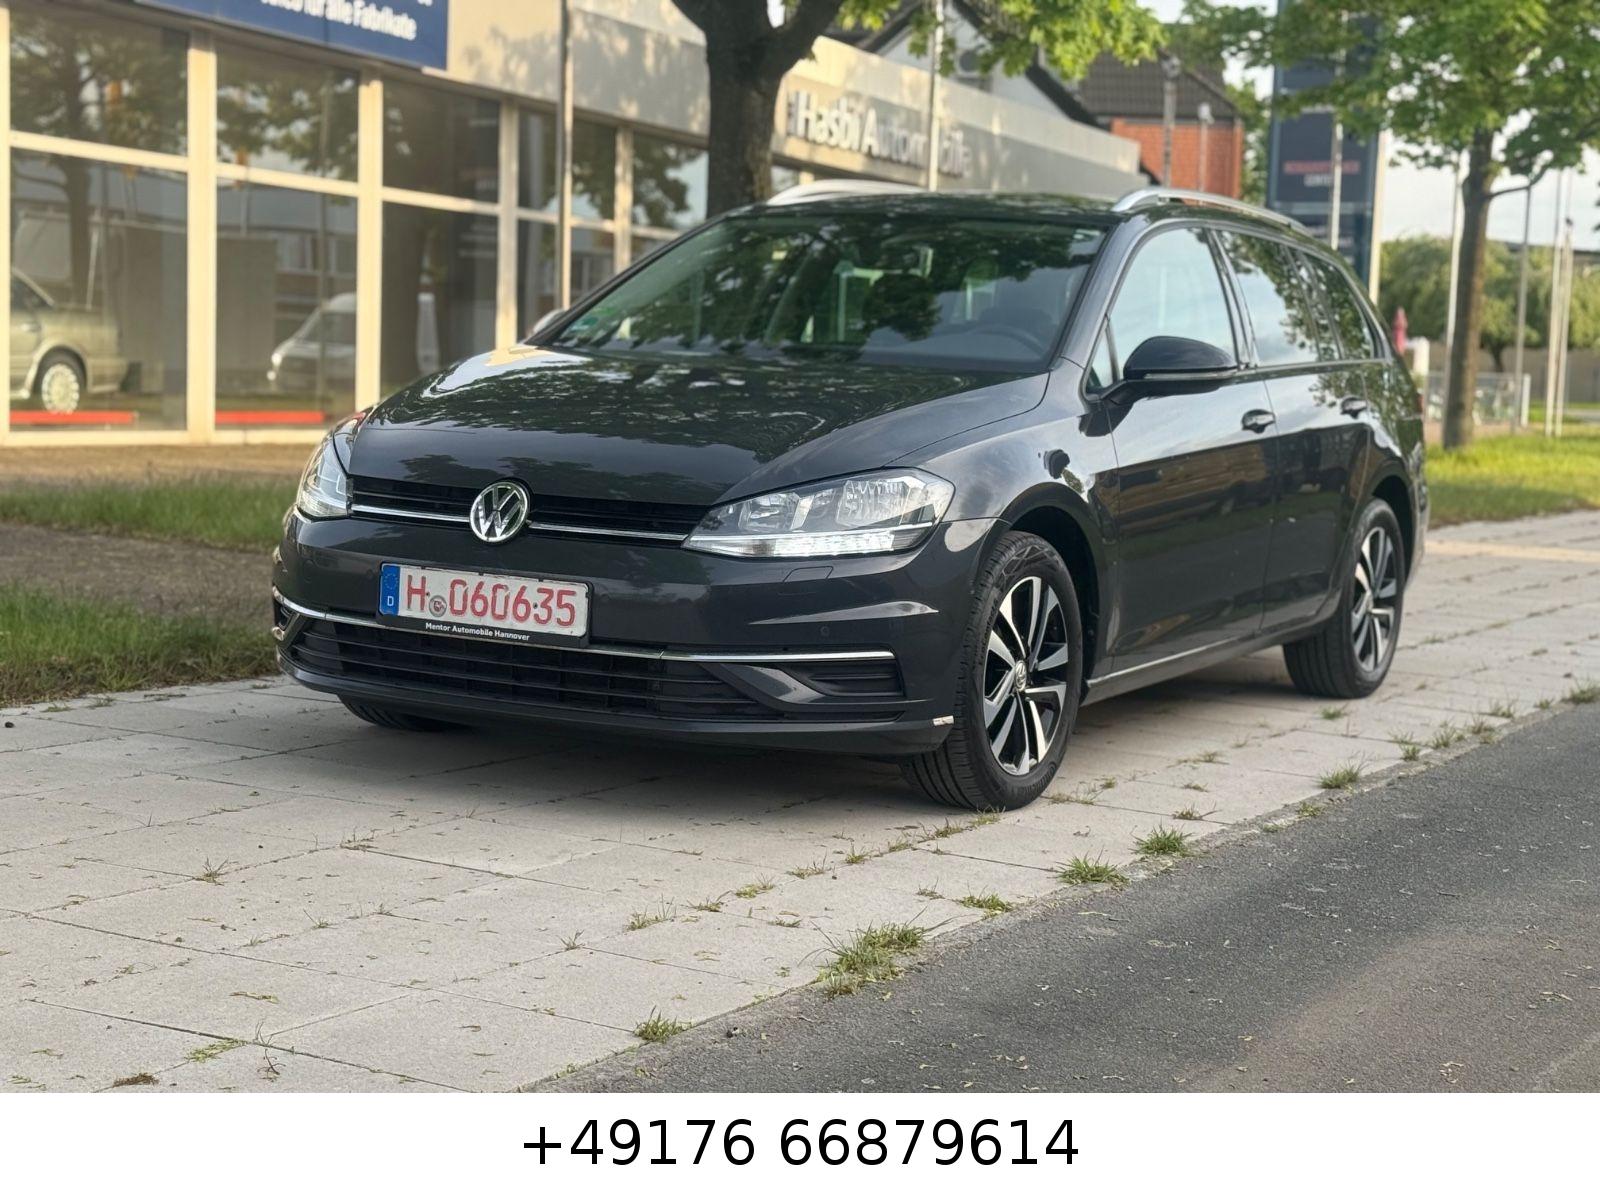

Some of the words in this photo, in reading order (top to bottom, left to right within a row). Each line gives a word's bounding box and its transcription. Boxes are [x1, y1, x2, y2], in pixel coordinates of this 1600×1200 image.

[387, 596, 393, 606] D
[425, 622, 450, 632] Mentor
[452, 625, 493, 637] Automobile
[494, 630, 530, 641] Hannover
